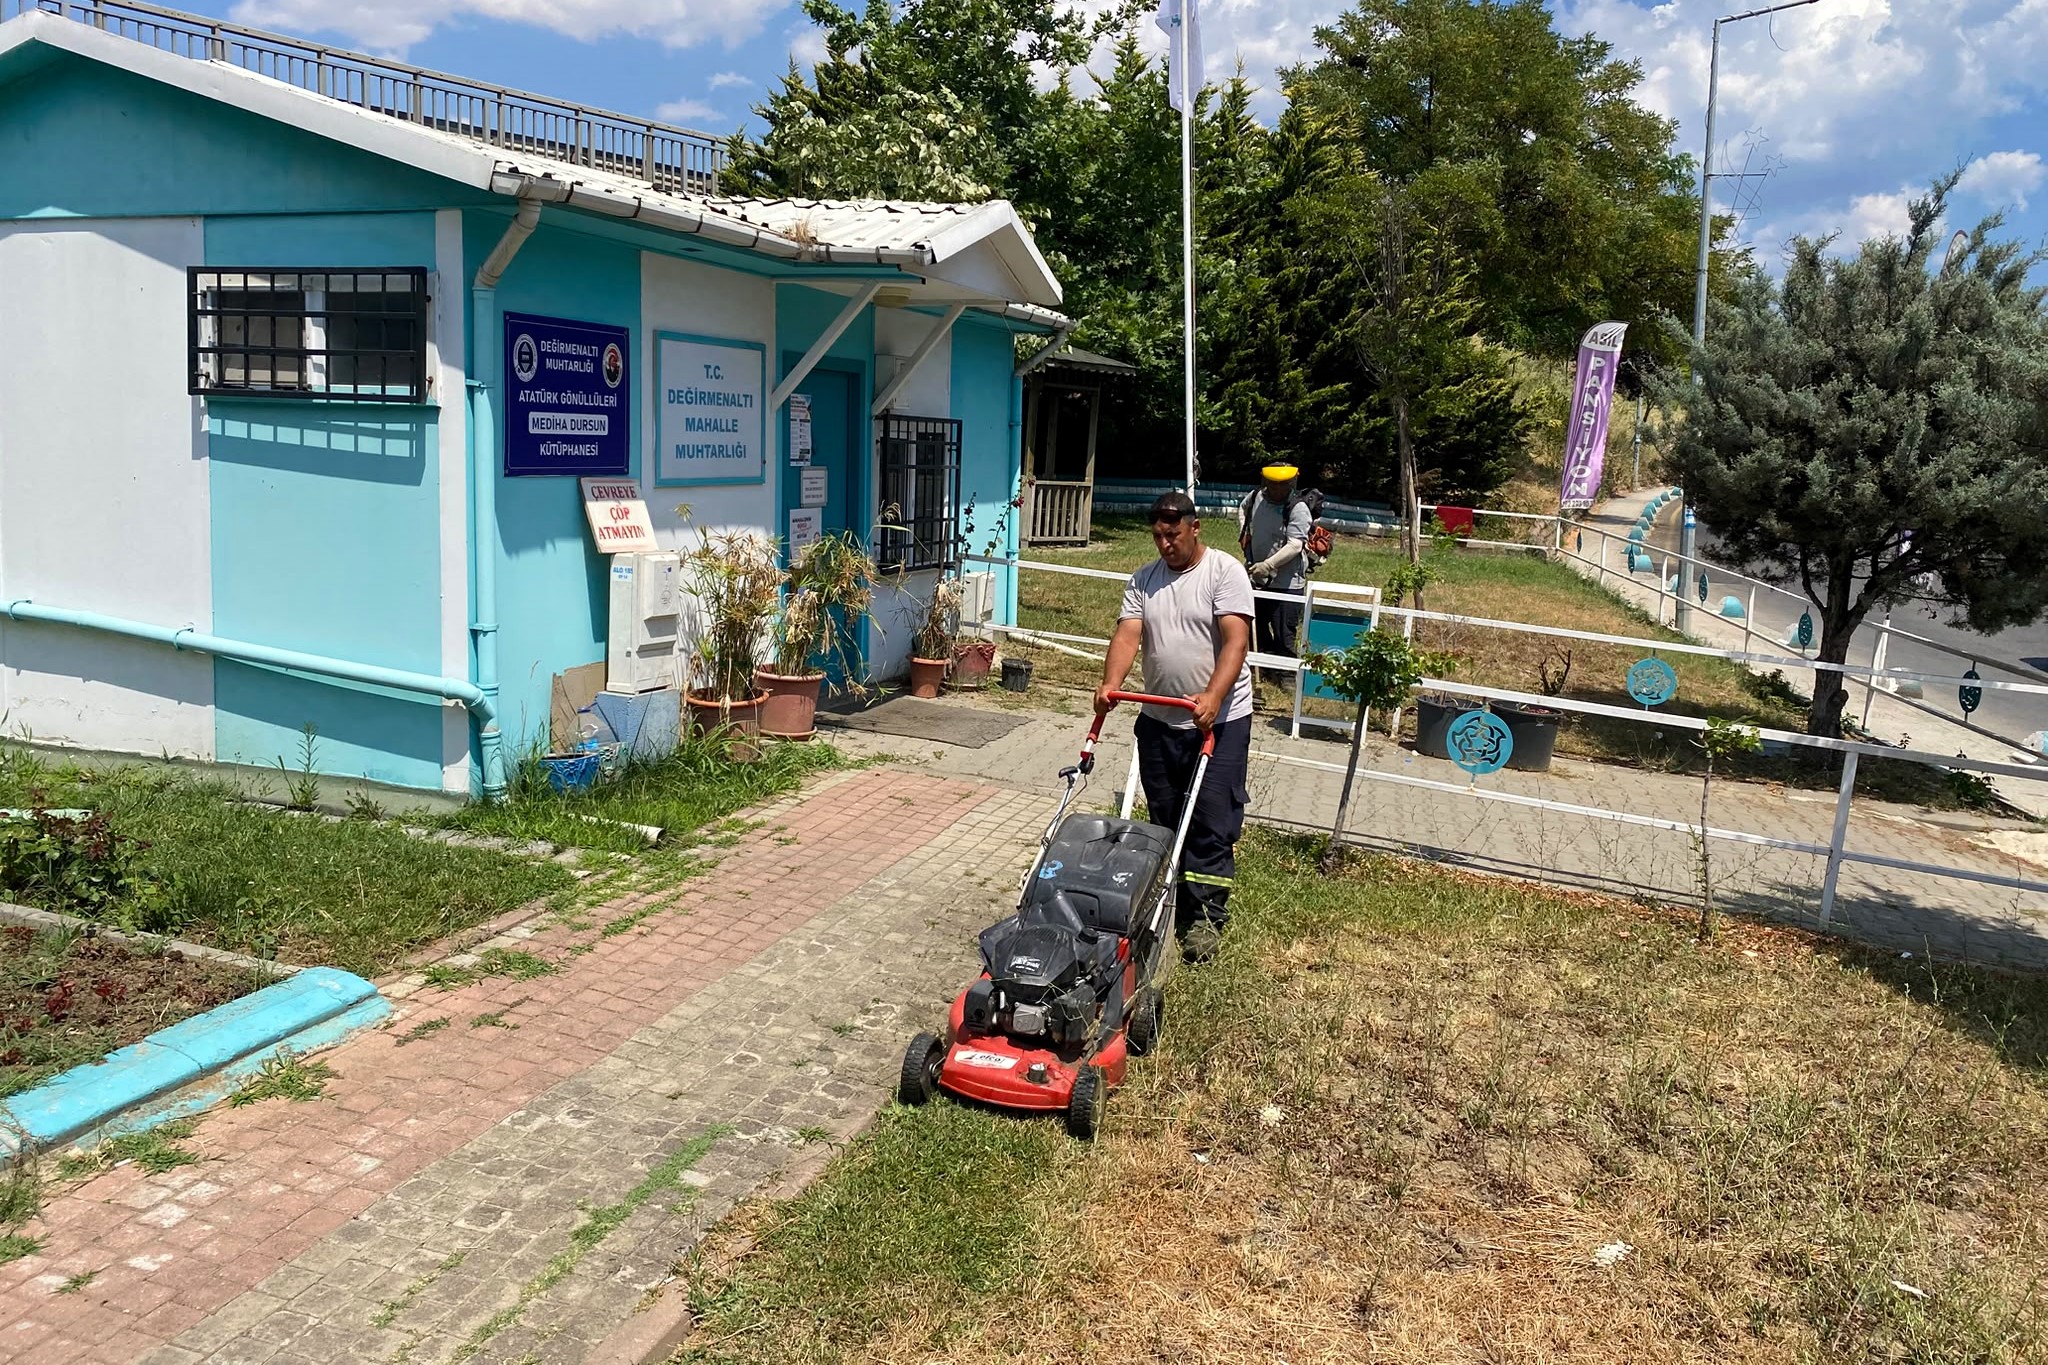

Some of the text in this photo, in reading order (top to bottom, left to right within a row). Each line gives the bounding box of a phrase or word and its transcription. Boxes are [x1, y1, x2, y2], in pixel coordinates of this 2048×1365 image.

[540, 339, 599, 358] DEĞİRMENALTI
[545, 358, 594, 374] MUHTARLIĞI
[703, 364, 724, 380] T.C.
[518, 388, 617, 408] ATATÜRK GÖNÜLLÜLERİ
[668, 387, 753, 408] DEĞİRMENALTI
[532, 415, 606, 432] MEDİHA DURSUN
[685, 417, 738, 433] MAHALLE
[540, 441, 599, 456] KÜTÜPHANESİ
[675, 442, 747, 459] MUHTARLIĞI
[591, 485, 637, 501] ÇEVREYE
[609, 505, 630, 524] ÇÖP
[598, 525, 646, 540] ATMAYIN
